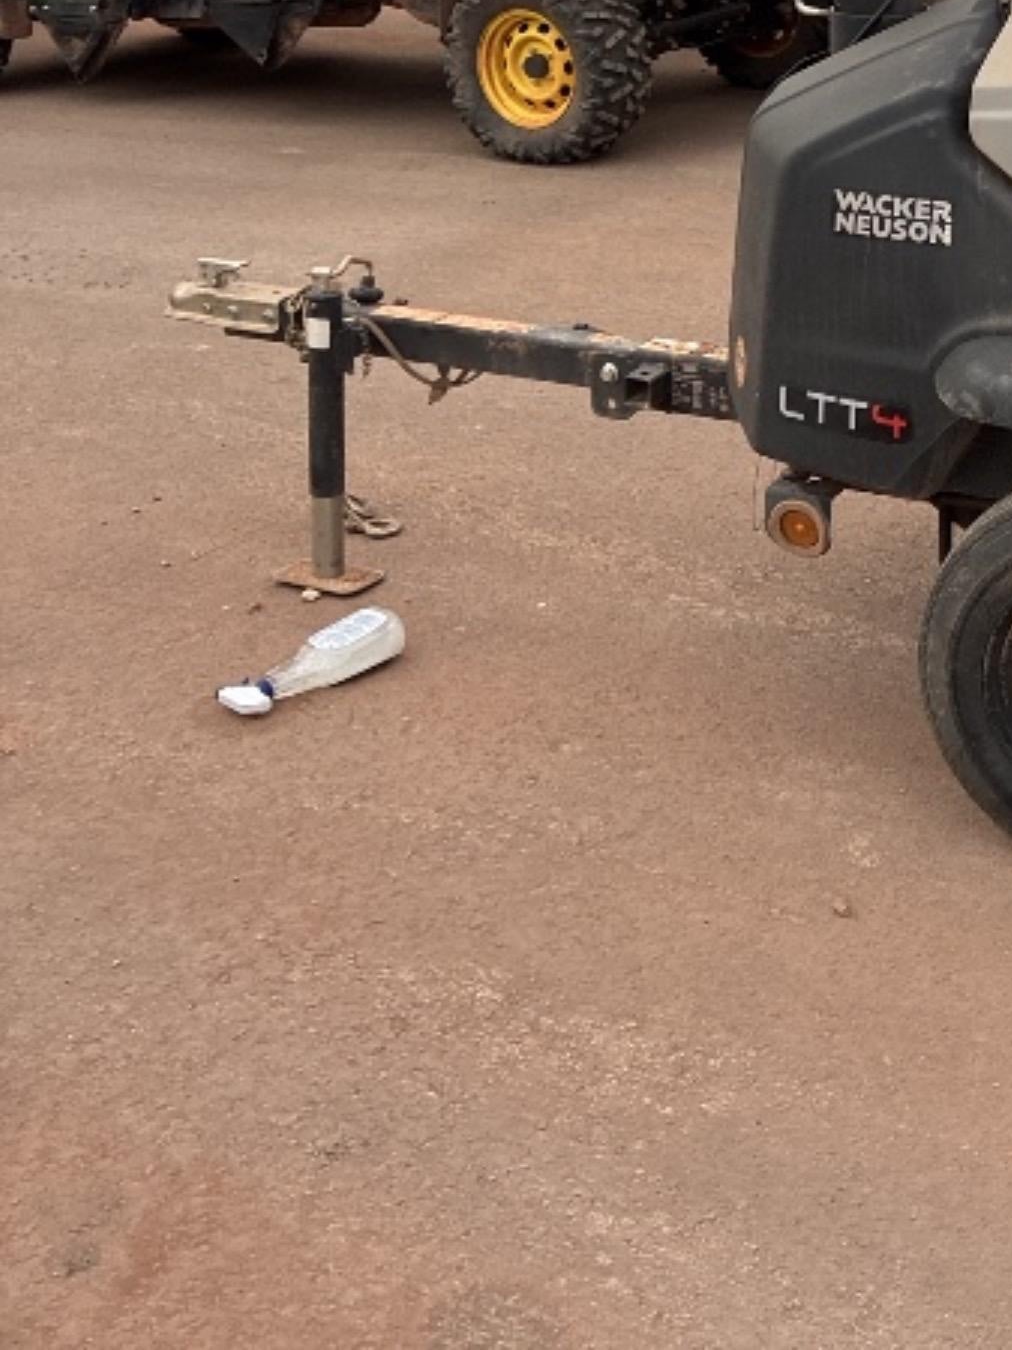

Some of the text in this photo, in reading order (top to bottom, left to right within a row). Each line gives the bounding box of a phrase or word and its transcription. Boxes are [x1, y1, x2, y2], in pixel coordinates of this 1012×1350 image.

[834, 188, 952, 223] WACKER
[833, 211, 952, 247] NEUSON
[779, 385, 907, 439] LTT4
